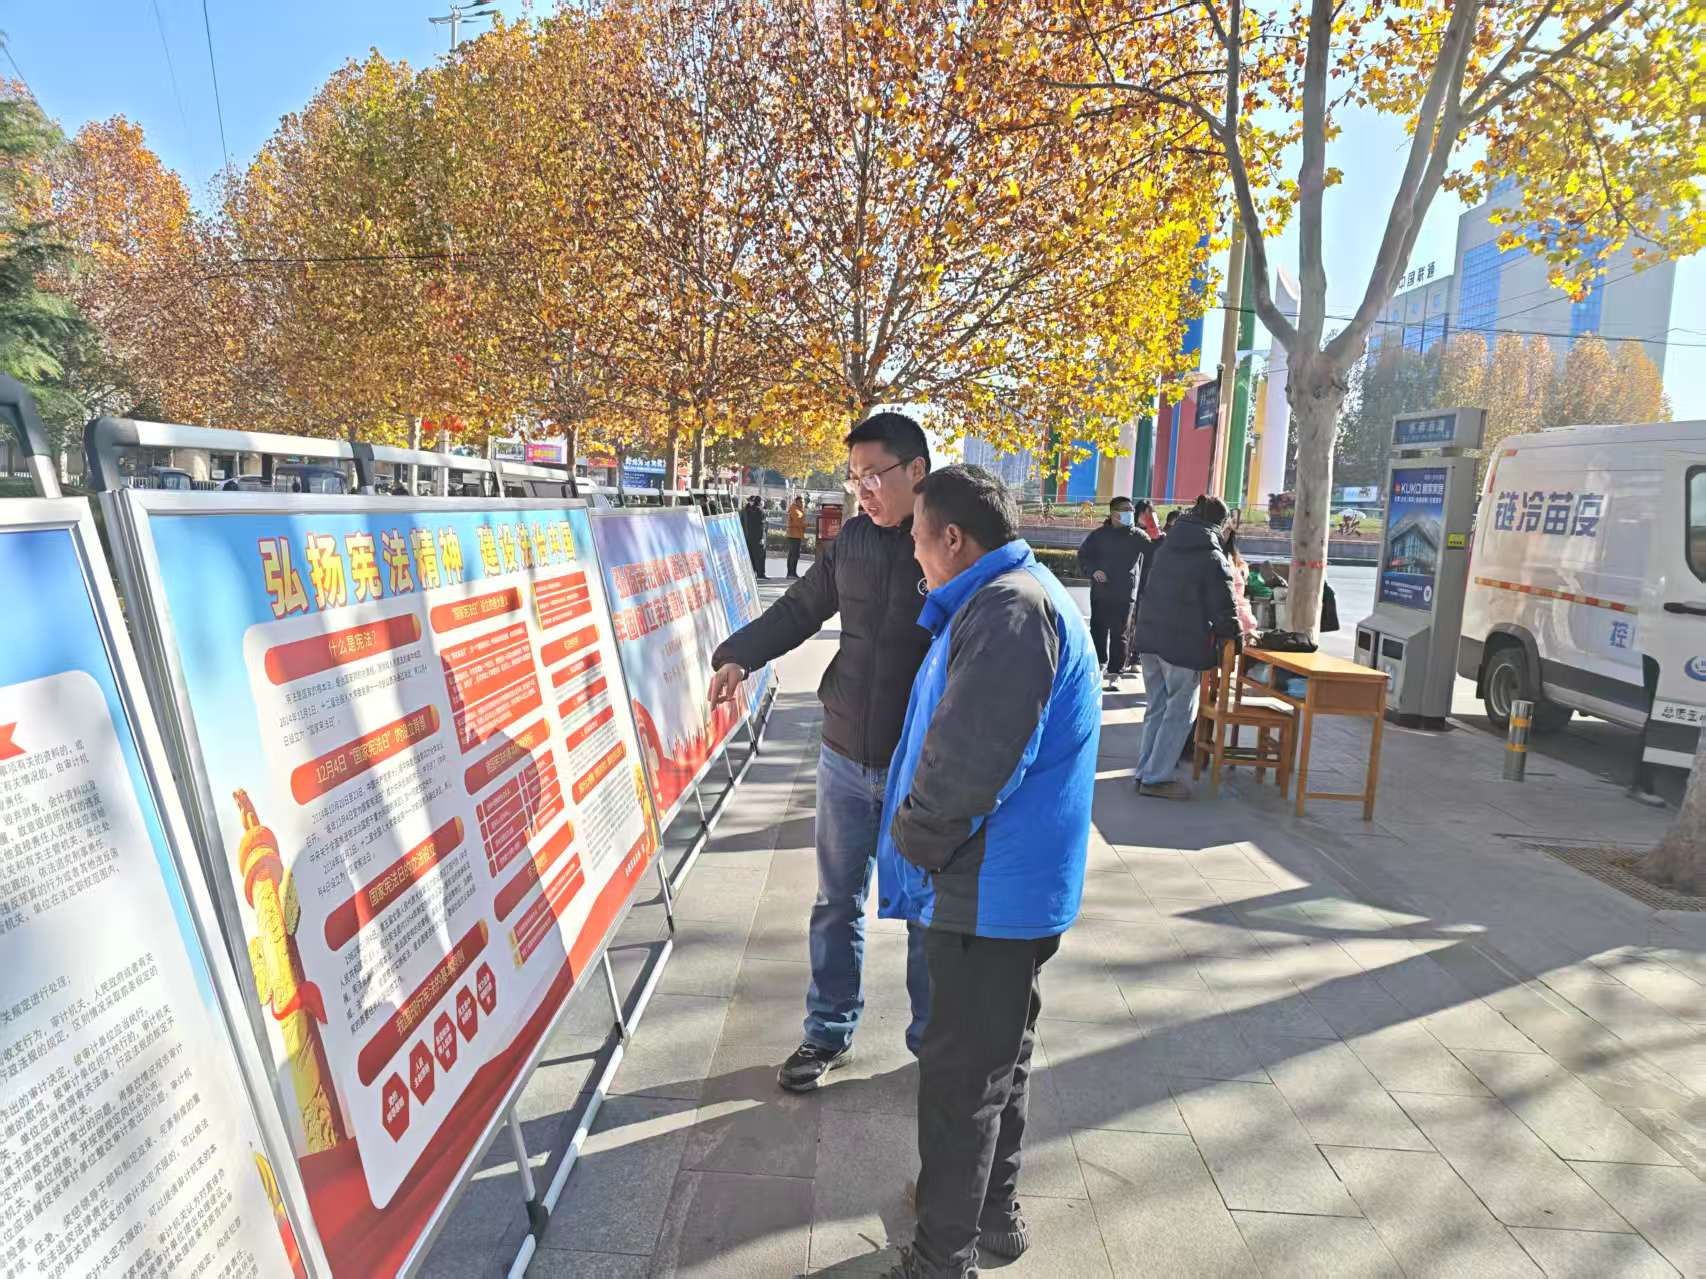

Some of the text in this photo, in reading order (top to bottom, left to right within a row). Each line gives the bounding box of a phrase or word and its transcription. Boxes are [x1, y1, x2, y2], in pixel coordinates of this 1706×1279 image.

[257, 520, 577, 619] 弘扬宪法精神 建设法治中国
